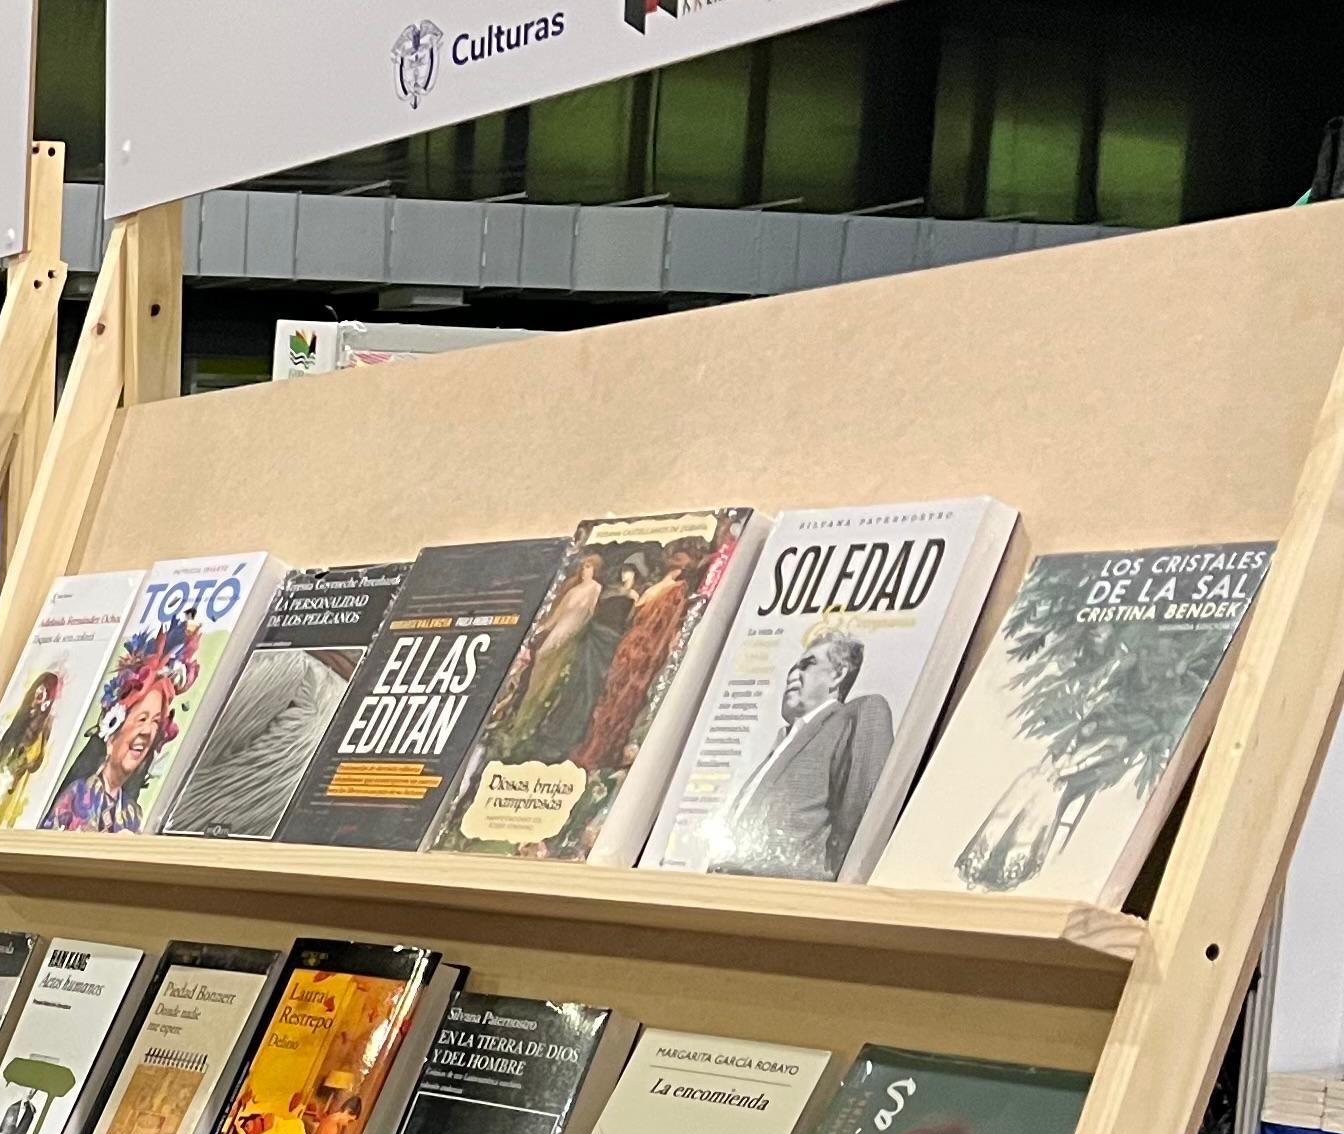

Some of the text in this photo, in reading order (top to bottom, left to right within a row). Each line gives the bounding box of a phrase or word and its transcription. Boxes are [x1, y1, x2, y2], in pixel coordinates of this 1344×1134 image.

[452, 12, 565, 66] Culturas
[757, 538, 945, 616] SOLEDAD
[1101, 551, 1267, 577] LOS CRISTALES
[140, 562, 247, 626] TOTÓ
[274, 595, 369, 611] LA PERSONALIDAD
[1086, 574, 1248, 605] DE LA SAL
[267, 609, 360, 627] DE LOS PELÍCANOS
[1076, 602, 1238, 623] CRISTINA BENDEK
[373, 634, 491, 694] ELLAS
[337, 695, 468, 754] EDITAN
[533, 778, 573, 799] brujas
[62, 976, 105, 996] humanos
[164, 981, 196, 999] Piedad
[290, 983, 324, 1004] Laura
[279, 1007, 332, 1034] Restrepo
[448, 1007, 537, 1030] Silvana Paternostro
[438, 1029, 580, 1063] EN LA TIERRA DE DIOS
[432, 1048, 526, 1076] Y DEL HOMBRE
[656, 1047, 799, 1076] MARGARITA GARCÍA ROBAYO
[649, 1078, 770, 1111] La encomienda
